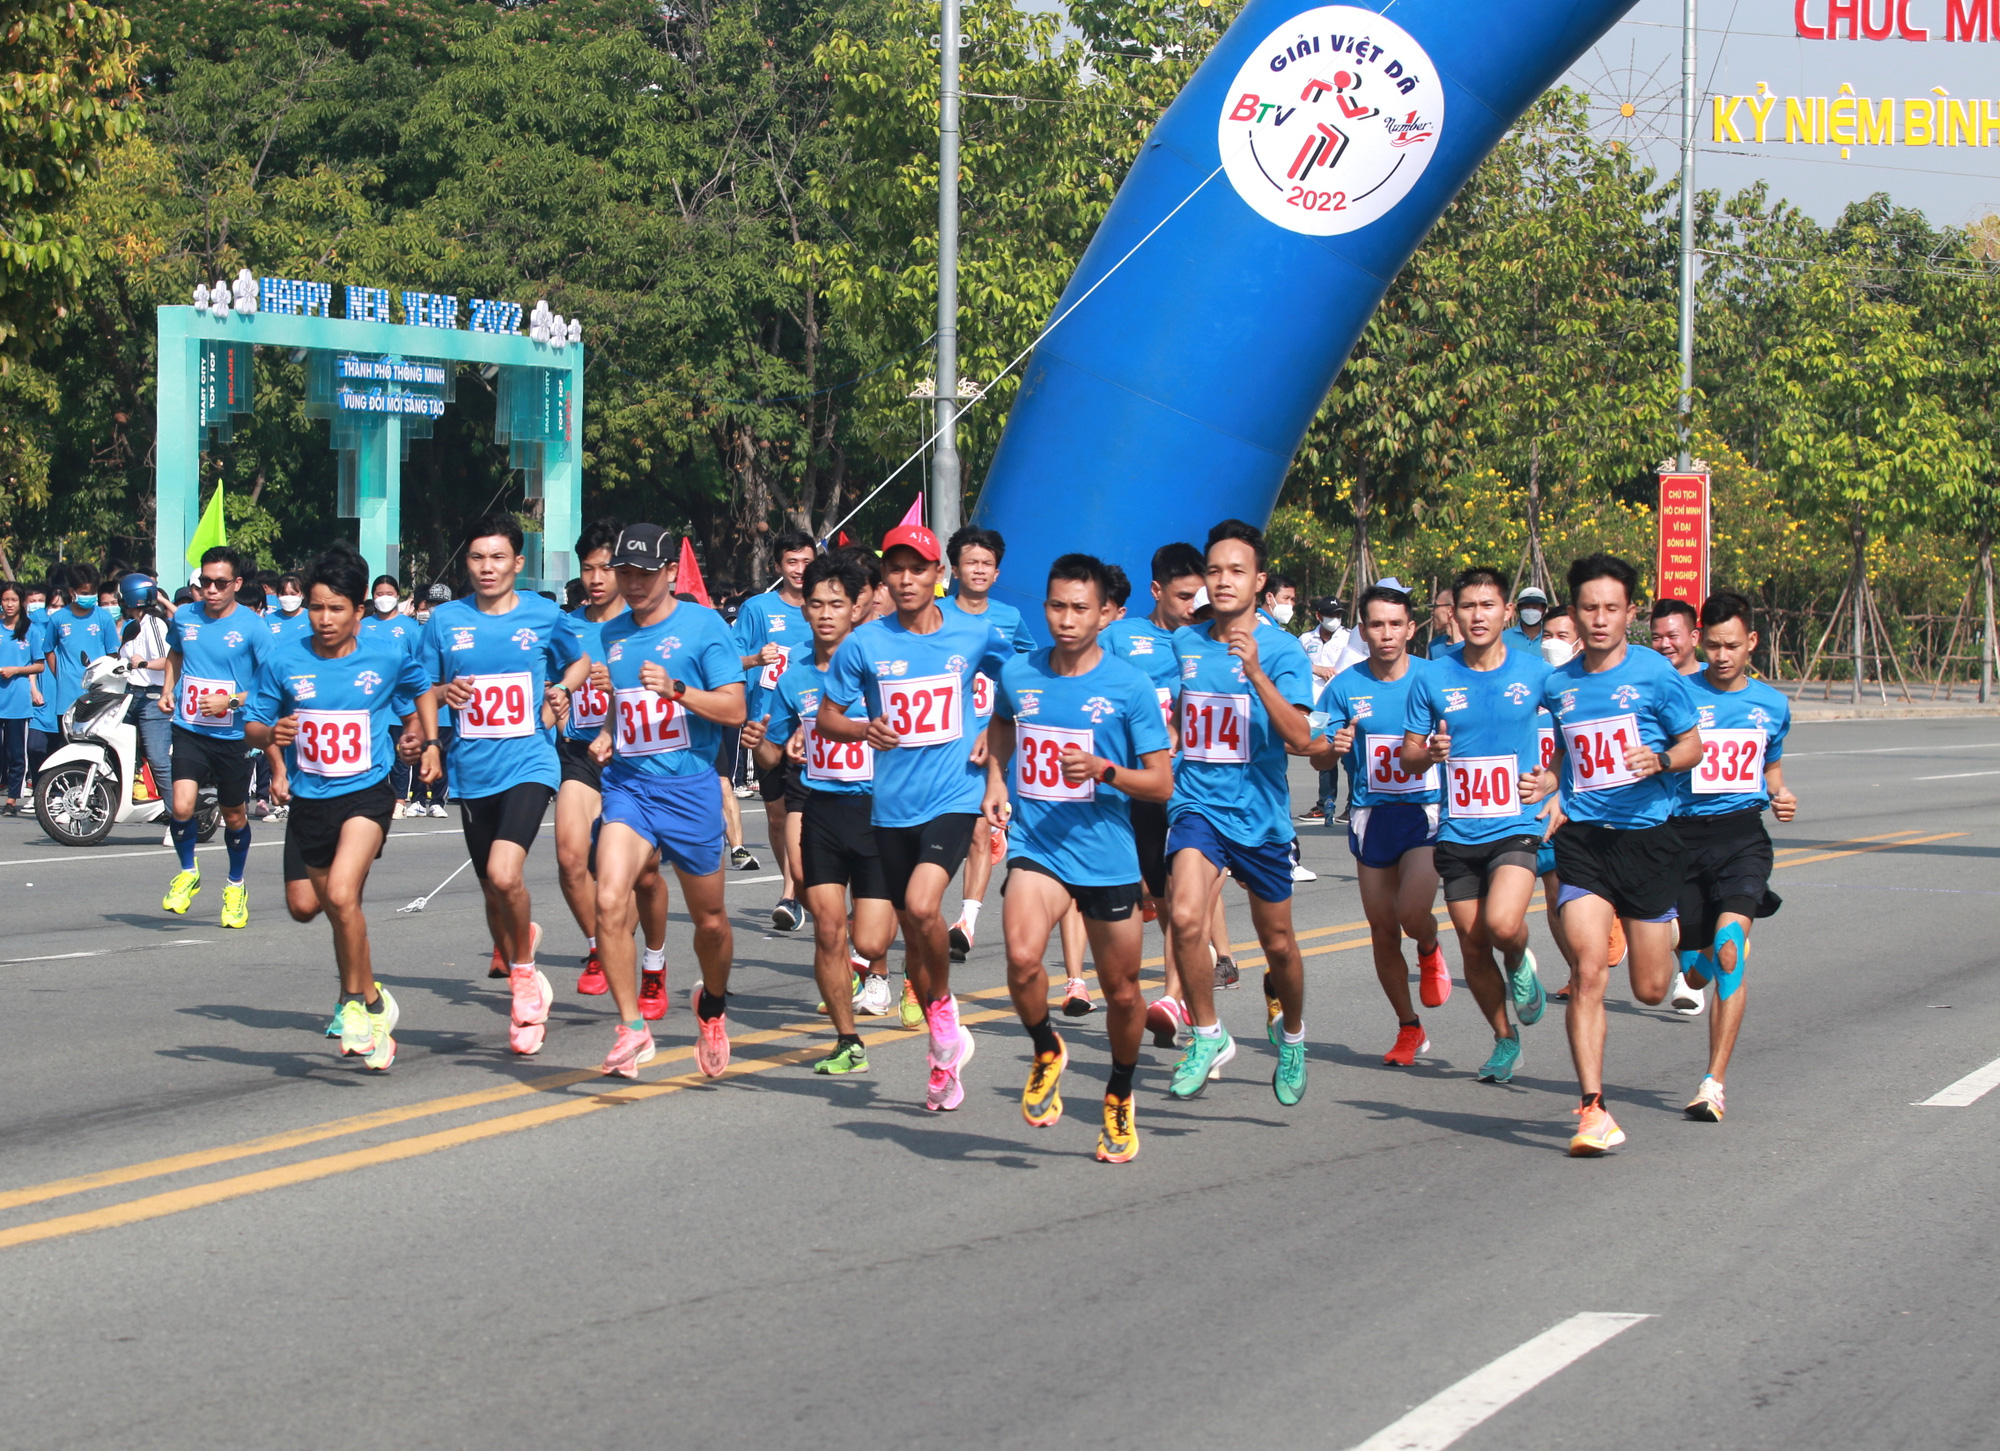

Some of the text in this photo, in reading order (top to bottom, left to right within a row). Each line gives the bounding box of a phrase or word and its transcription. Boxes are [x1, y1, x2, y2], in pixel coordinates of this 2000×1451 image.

[1270, 34, 1420, 96] GIẢI VIỆT DÃ
[1229, 93, 1297, 127] BTV
[1383, 115, 1432, 135] Number
[1712, 82, 1778, 143] KỶ
[1785, 82, 1896, 160] NIỆM
[1286, 186, 1347, 211] 2022
[260, 277, 522, 337] HAPPY NEW YEAR 2022
[210, 375, 216, 383] 7
[344, 356, 445, 384] THÀNH PHỐ THÔNG MINH
[404, 395, 428, 415] SÁNG
[430, 401, 445, 419] TẠO
[1674, 505, 1685, 515] CHÍ
[1685, 507, 1701, 515] MINH
[1683, 490, 1697, 501] TỊCH
[1671, 555, 1692, 563] TRONG
[1674, 571, 1698, 581] NGHIỆP
[1674, 586, 1687, 596] CỦA
[467, 684, 525, 726] 329
[620, 697, 680, 746] 312
[890, 686, 953, 736] 327
[302, 721, 362, 764] 333
[1184, 703, 1239, 751] 314
[811, 729, 864, 770] 328
[1374, 742, 1428, 784] 33
[1573, 728, 1627, 778] 341
[1700, 740, 1758, 781] 332
[1454, 766, 1511, 807] 340
